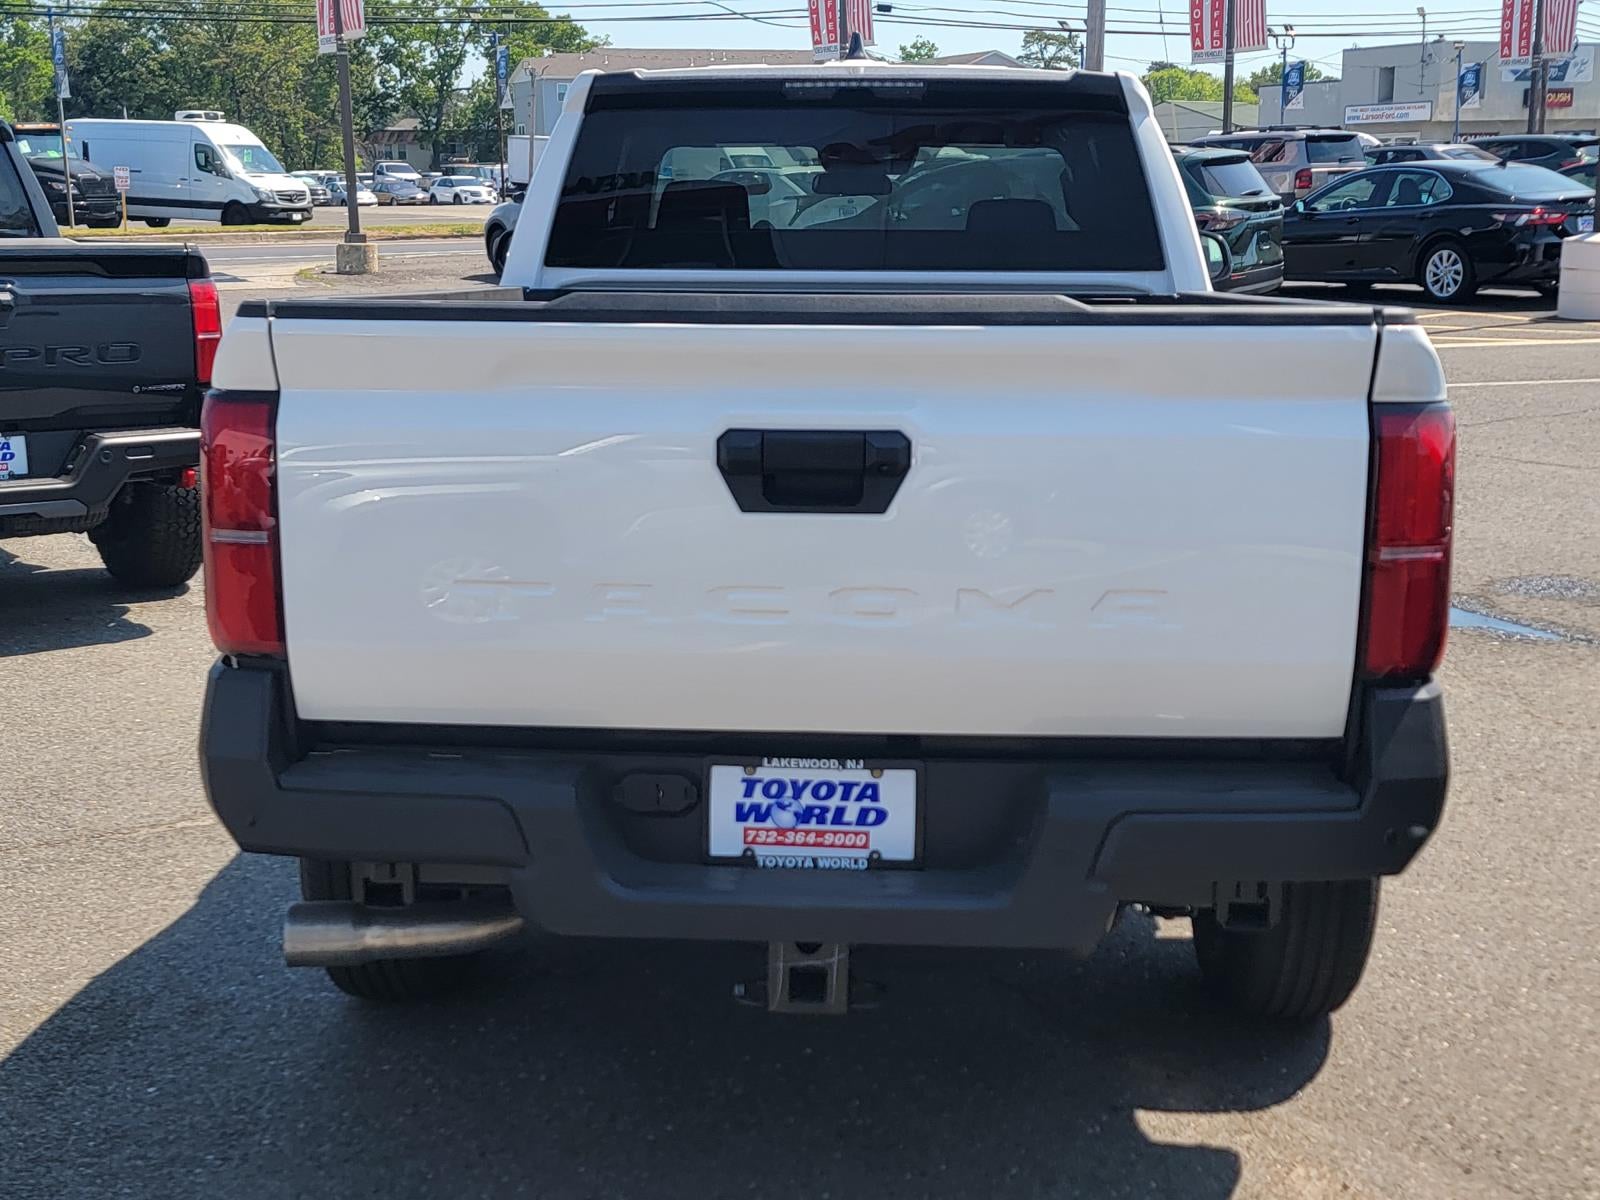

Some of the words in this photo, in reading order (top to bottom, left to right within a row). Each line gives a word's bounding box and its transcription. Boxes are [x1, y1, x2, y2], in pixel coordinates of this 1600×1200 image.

[1546, 92, 1571, 104] OUSH
[452, 579, 1184, 630] TACOMA
[762, 757, 842, 770] LAKEWOOD,
[847, 759, 864, 769] NJ
[741, 777, 881, 803] TOYOTA
[735, 802, 889, 828] WORLD
[745, 830, 867, 846] 732-364-9000
[757, 856, 814, 868] TOYOTA
[817, 857, 868, 870] WORLD
